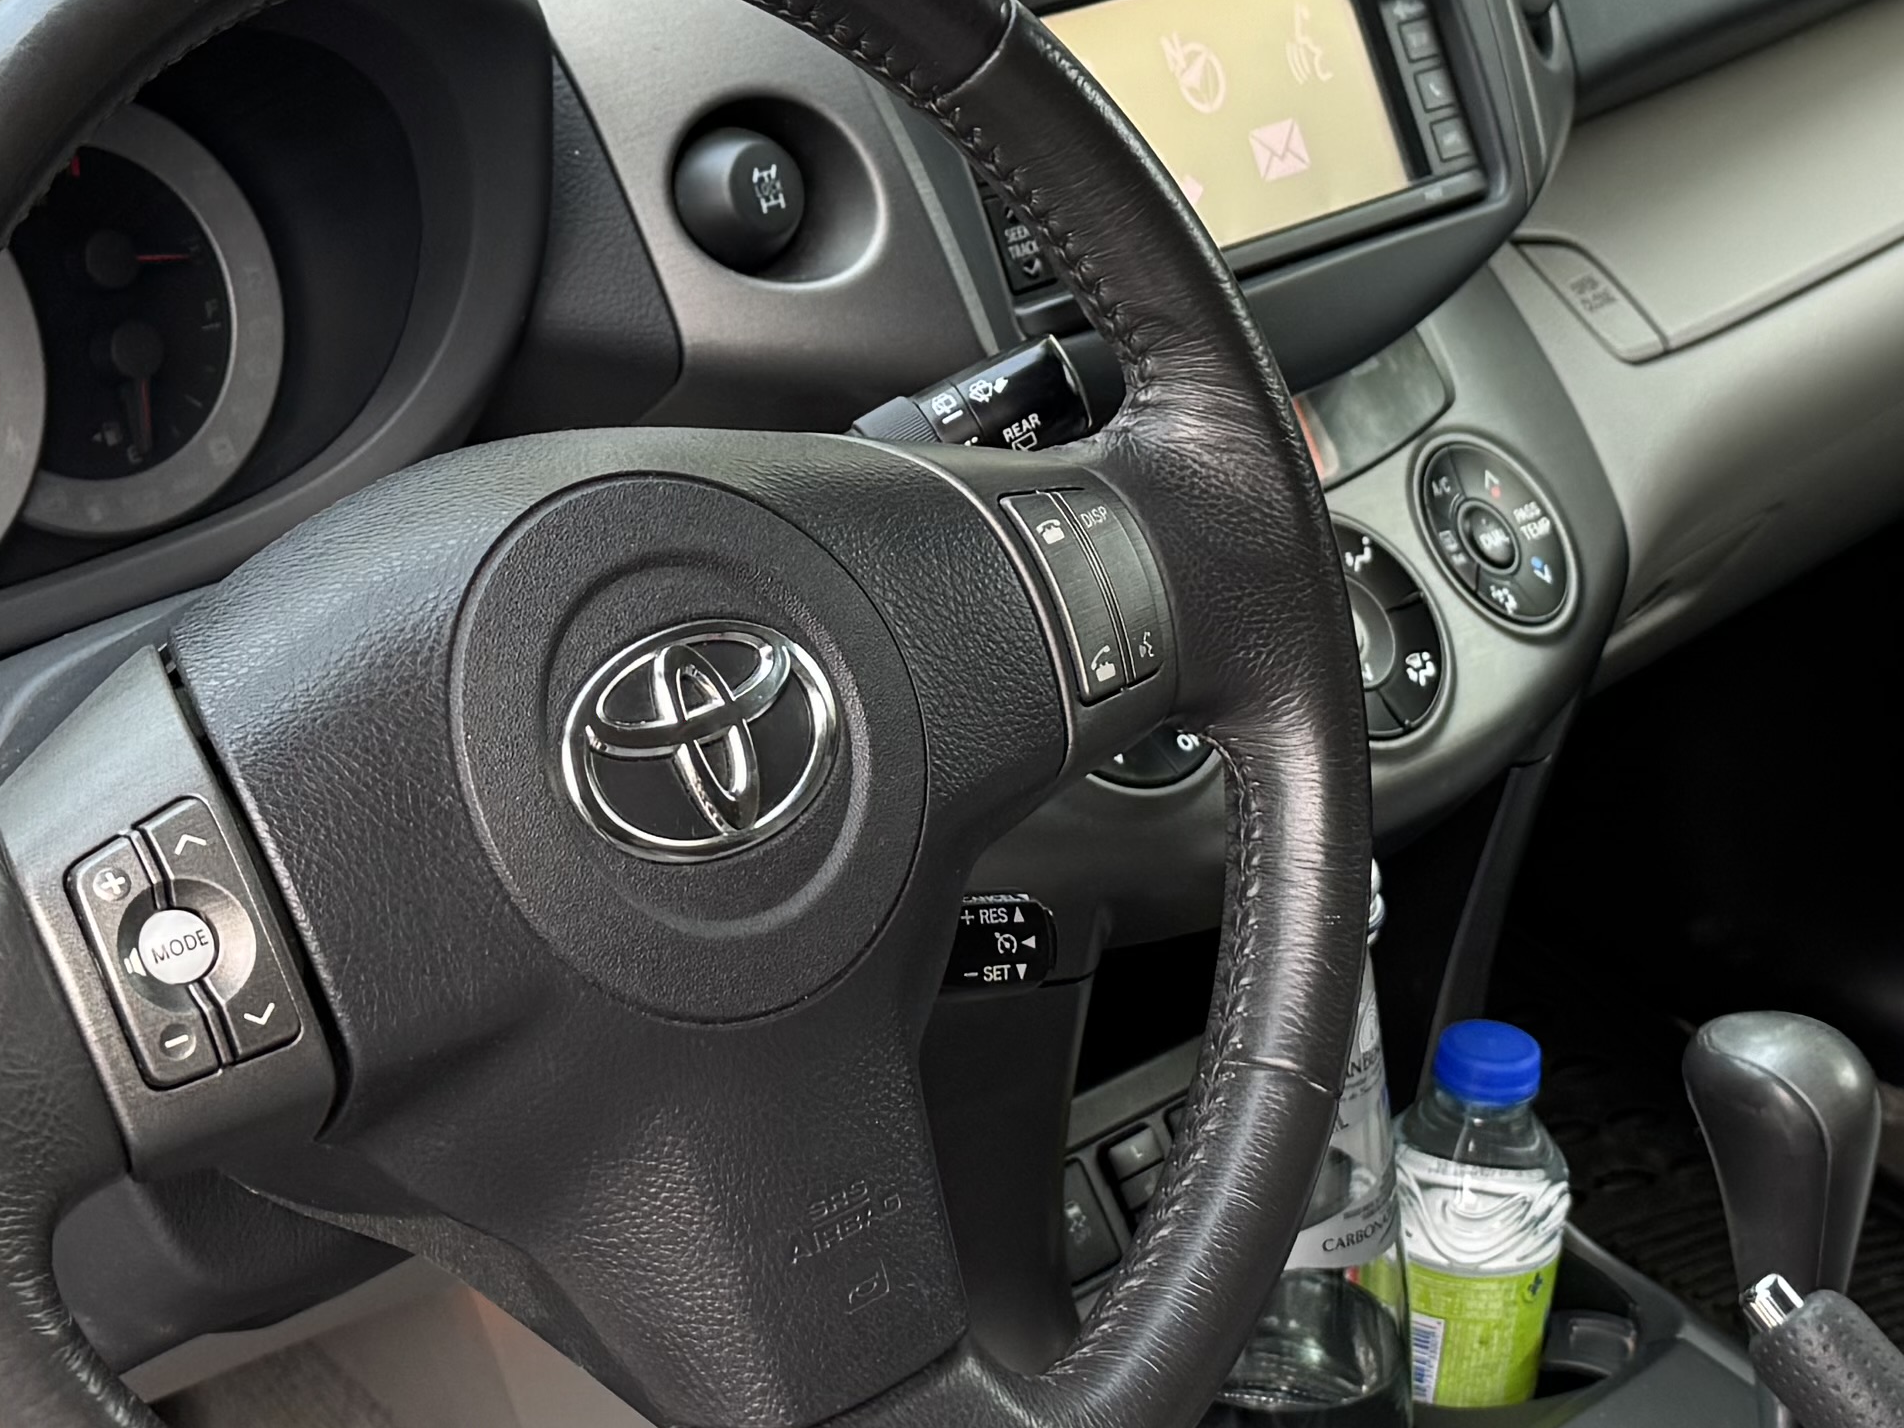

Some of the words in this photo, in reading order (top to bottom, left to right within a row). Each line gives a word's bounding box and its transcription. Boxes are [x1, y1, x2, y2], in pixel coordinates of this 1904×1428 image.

[1002, 413, 1042, 443] REAR
[1080, 505, 1107, 529] DISP
[979, 907, 1008, 925] RES
[151, 929, 209, 965] MODE
[983, 964, 1011, 982] SET
